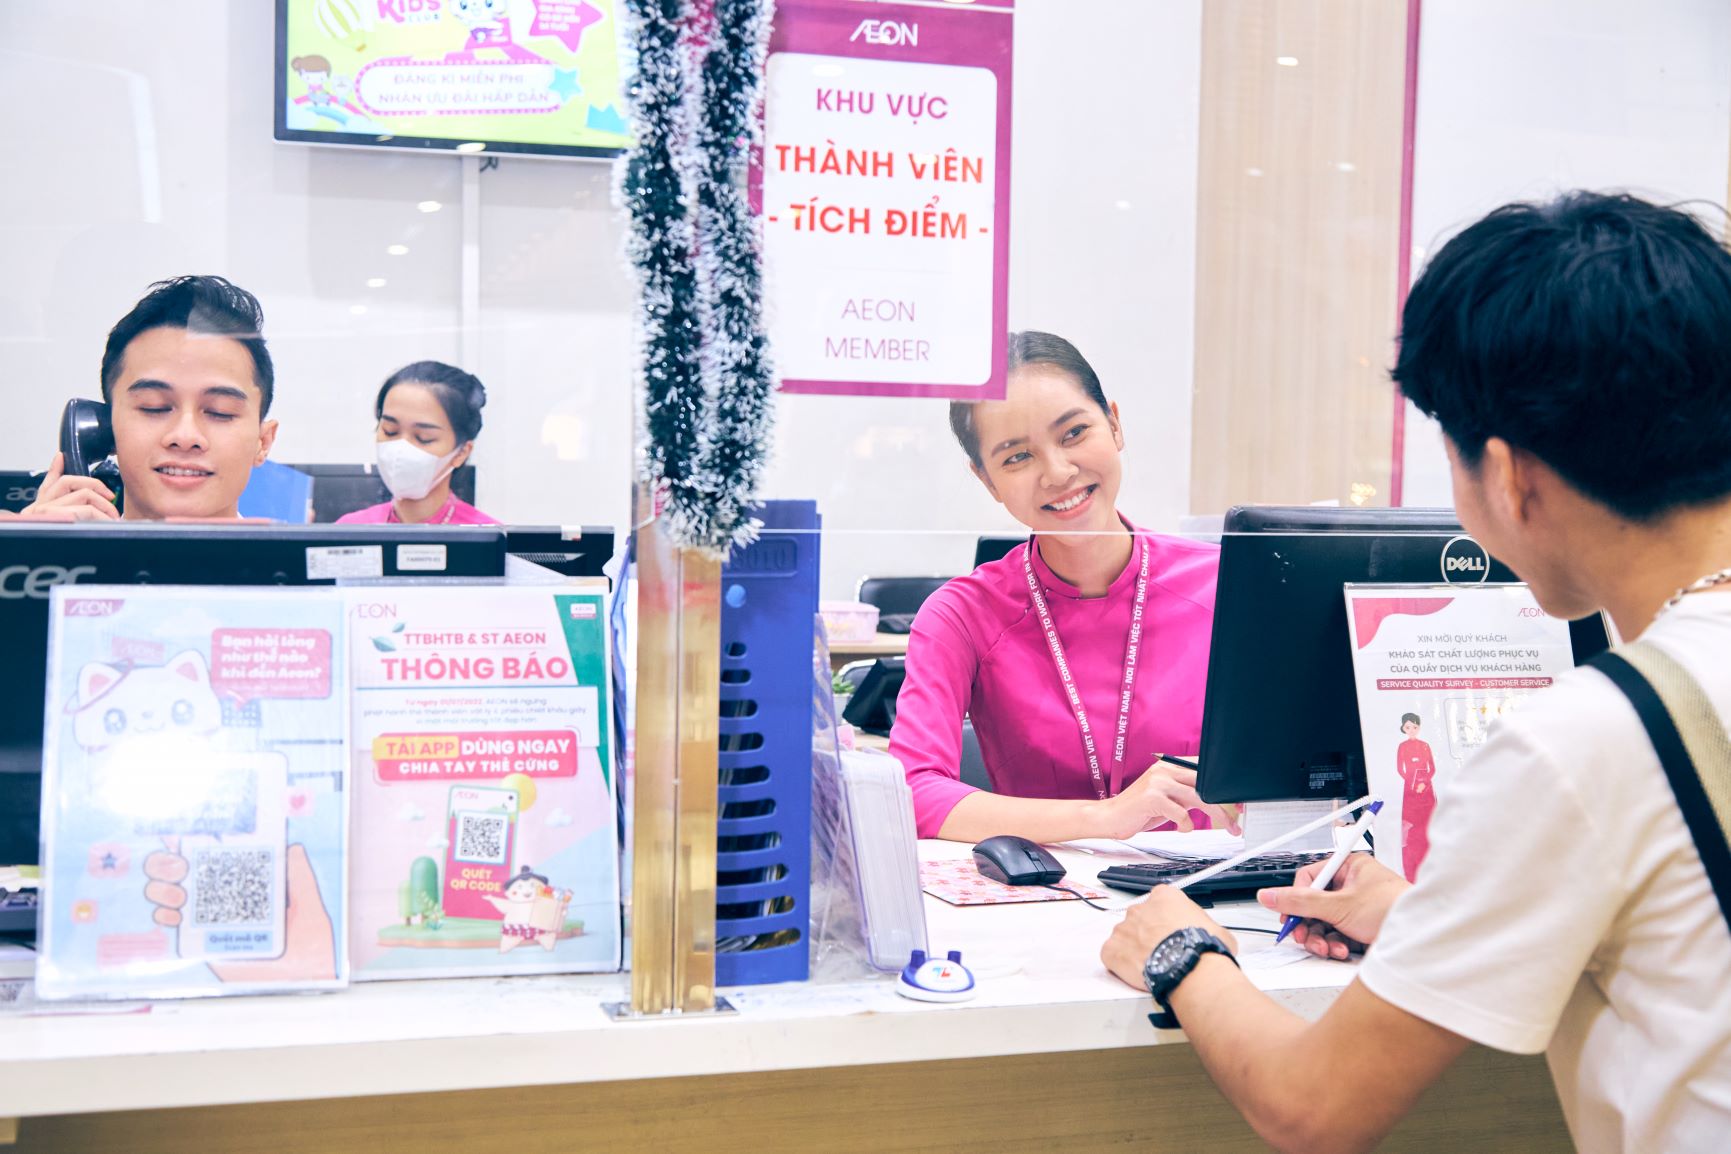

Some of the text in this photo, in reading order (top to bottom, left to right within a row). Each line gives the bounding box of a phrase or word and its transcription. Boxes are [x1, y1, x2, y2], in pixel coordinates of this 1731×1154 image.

[816, 88, 949, 125] KHU VỰC
[775, 139, 983, 183] THÀNH VIÊN
[790, 196, 870, 234] TÍCH
[885, 195, 967, 239] ĐIỂM
[841, 298, 915, 322] AEON
[825, 337, 930, 361] MEMBER
[5, 487, 39, 501] ac
[1446, 556, 1485, 571] DELL
[0, 565, 96, 598] cer
[1027, 573, 1038, 590] FOR
[1032, 590, 1048, 617] WORK
[1043, 617, 1053, 630] TO
[1130, 623, 1141, 643] VIỆC
[404, 631, 546, 645] TTBHTB & ST AEON
[1417, 632, 1508, 644] XIN MỜI QUÝ KHÁCH
[1047, 631, 1071, 682] COMPANIES
[1126, 645, 1138, 666] LÀM
[1389, 648, 1416, 659] KHẢO
[1418, 648, 1435, 658] SÁT
[1438, 646, 1463, 658] CHẤT
[1499, 649, 1524, 660] PHỤC
[380, 651, 568, 680] THÔNG BÁO
[1390, 663, 1410, 673] CỦA
[1440, 664, 1463, 674] DỊCH
[1464, 664, 1478, 674] VỤ
[1480, 662, 1513, 672] KHÁCH
[1515, 661, 1542, 672] HÀNG
[1380, 680, 1412, 688] SERVICE
[1412, 680, 1444, 688] QUALITY
[1445, 679, 1474, 688] SURVEY
[1480, 679, 1520, 687] CUSTOMER
[1520, 678, 1551, 687] SERVICE
[1066, 683, 1080, 705] BEST
[1120, 690, 1131, 713] NAM
[1077, 711, 1090, 733] NAM
[1117, 714, 1128, 735] VIỆT
[386, 736, 570, 756] TẢI APP DÙNG NGAY
[1115, 736, 1125, 762] AEON
[400, 757, 560, 774] CHIA TAY THẺ CỨNG
[1089, 755, 1101, 780] AEON
[462, 867, 492, 879] QUÉT
[450, 879, 501, 893] QR CODE
